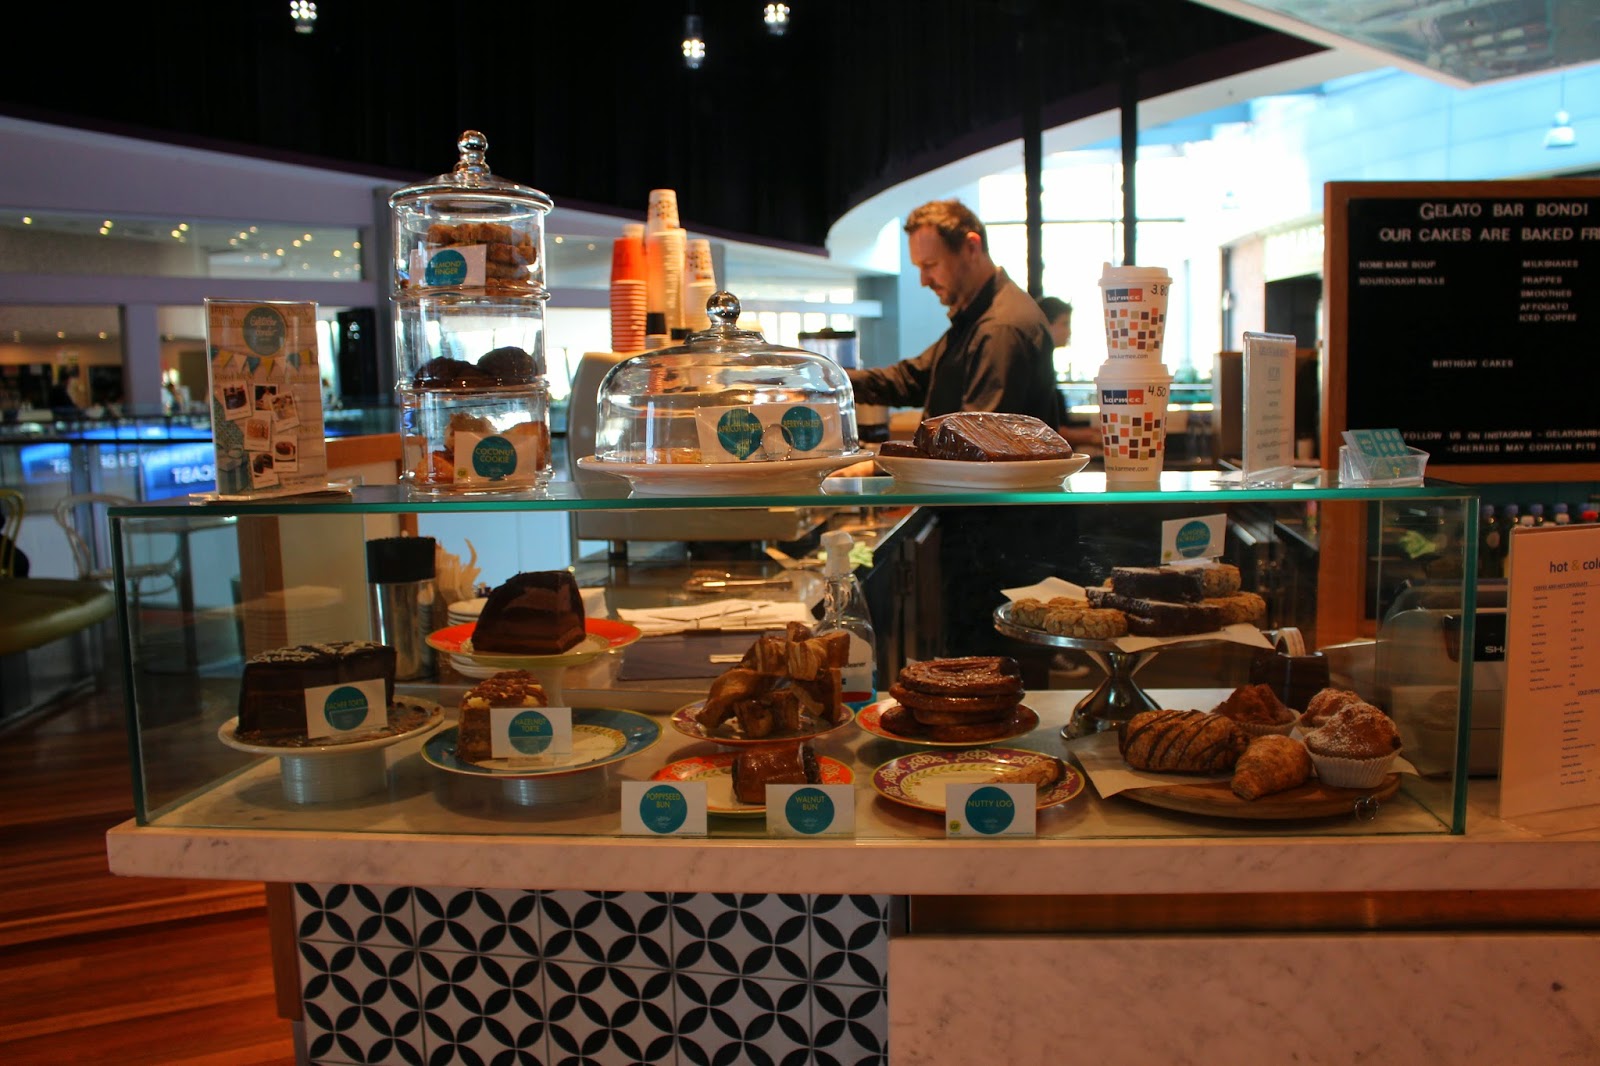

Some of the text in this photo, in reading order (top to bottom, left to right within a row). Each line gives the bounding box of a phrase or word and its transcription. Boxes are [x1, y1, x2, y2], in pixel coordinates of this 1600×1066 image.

[1420, 202, 1588, 220] GELATO BAR BONDI
[1379, 228, 1411, 242] OUR
[1419, 228, 1471, 242] CAKES
[1480, 227, 1510, 241] ARE
[1521, 227, 1574, 241] BAKED
[1522, 260, 1579, 268] MILKSHAKES
[1520, 289, 1572, 298] SMOOTHIES
[1520, 302, 1569, 311] AFFOGATO
[1519, 313, 1577, 322] ICED COFFEE
[1432, 359, 1514, 368] BIRTHDAY CAKES
[1148, 385, 1167, 397] 4.50
[1403, 431, 1442, 440] FOLLOW
[1450, 430, 1461, 440] US
[1468, 430, 1480, 440] ON
[1484, 430, 1532, 440] INSTAGRAM
[1546, 429, 1600, 438] GELATOBARB
[1506, 443, 1525, 453] MAY
[1529, 442, 1573, 452] CONTAIN
[1576, 441, 1597, 451] PITS
[475, 448, 515, 456] COCONUT
[480, 455, 510, 463] COOKIE
[1550, 561, 1568, 574] hot
[1571, 560, 1580, 571] &
[646, 792, 681, 801] POPPYSEED
[795, 795, 825, 803] WALNUT
[802, 803, 818, 811] BUN
